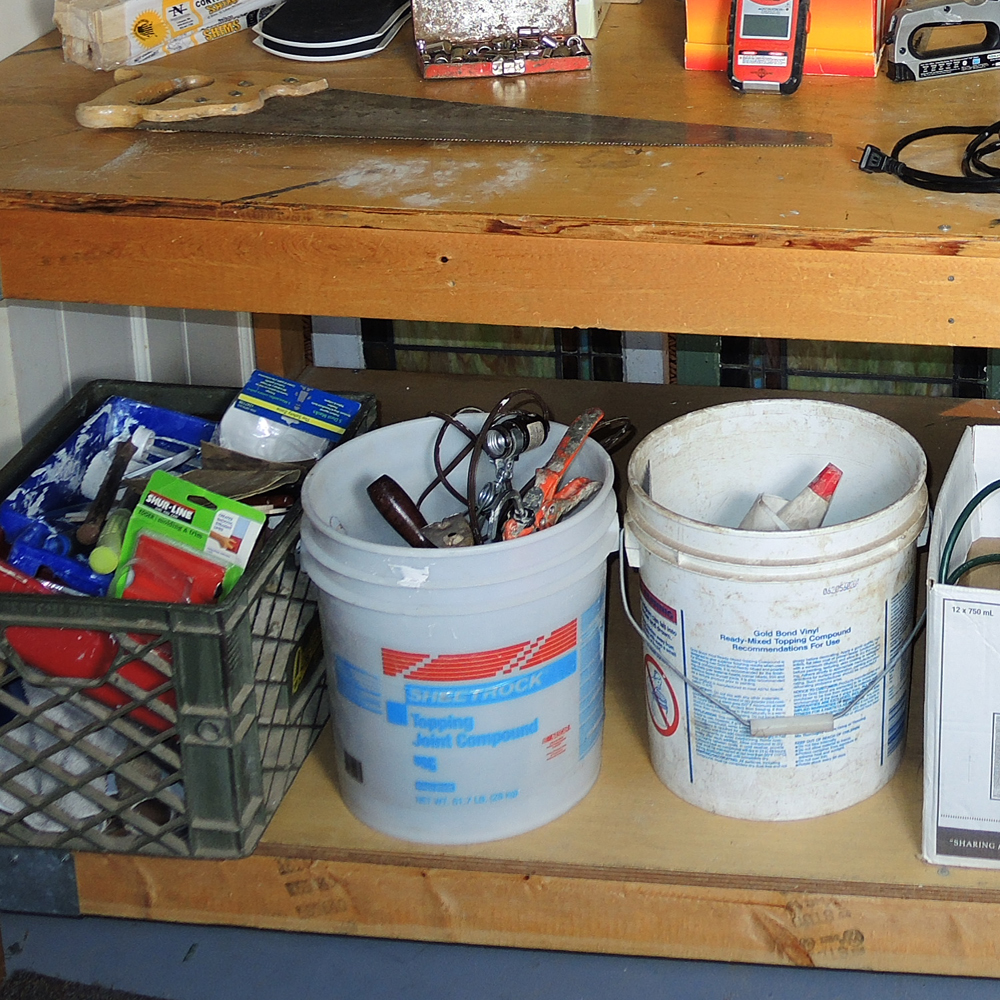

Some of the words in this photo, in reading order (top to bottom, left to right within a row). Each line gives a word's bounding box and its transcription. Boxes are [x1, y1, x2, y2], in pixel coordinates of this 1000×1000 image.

[203, 19, 241, 41] SHIMS
[189, 529, 203, 539] trim
[720, 634, 772, 645] Ready-Mixed
[775, 637, 807, 645] Topping
[809, 627, 852, 642] Compound
[753, 629, 773, 637] Gold
[776, 629, 797, 637] Bond
[800, 627, 820, 636] Vinyl
[732, 644, 808, 653] Recommendations
[811, 640, 823, 649] For
[826, 638, 841, 647] Use
[411, 671, 544, 703] SHEETROCK
[412, 713, 475, 732] Topping
[413, 733, 453, 748] Joint
[456, 717, 540, 749] Compound
